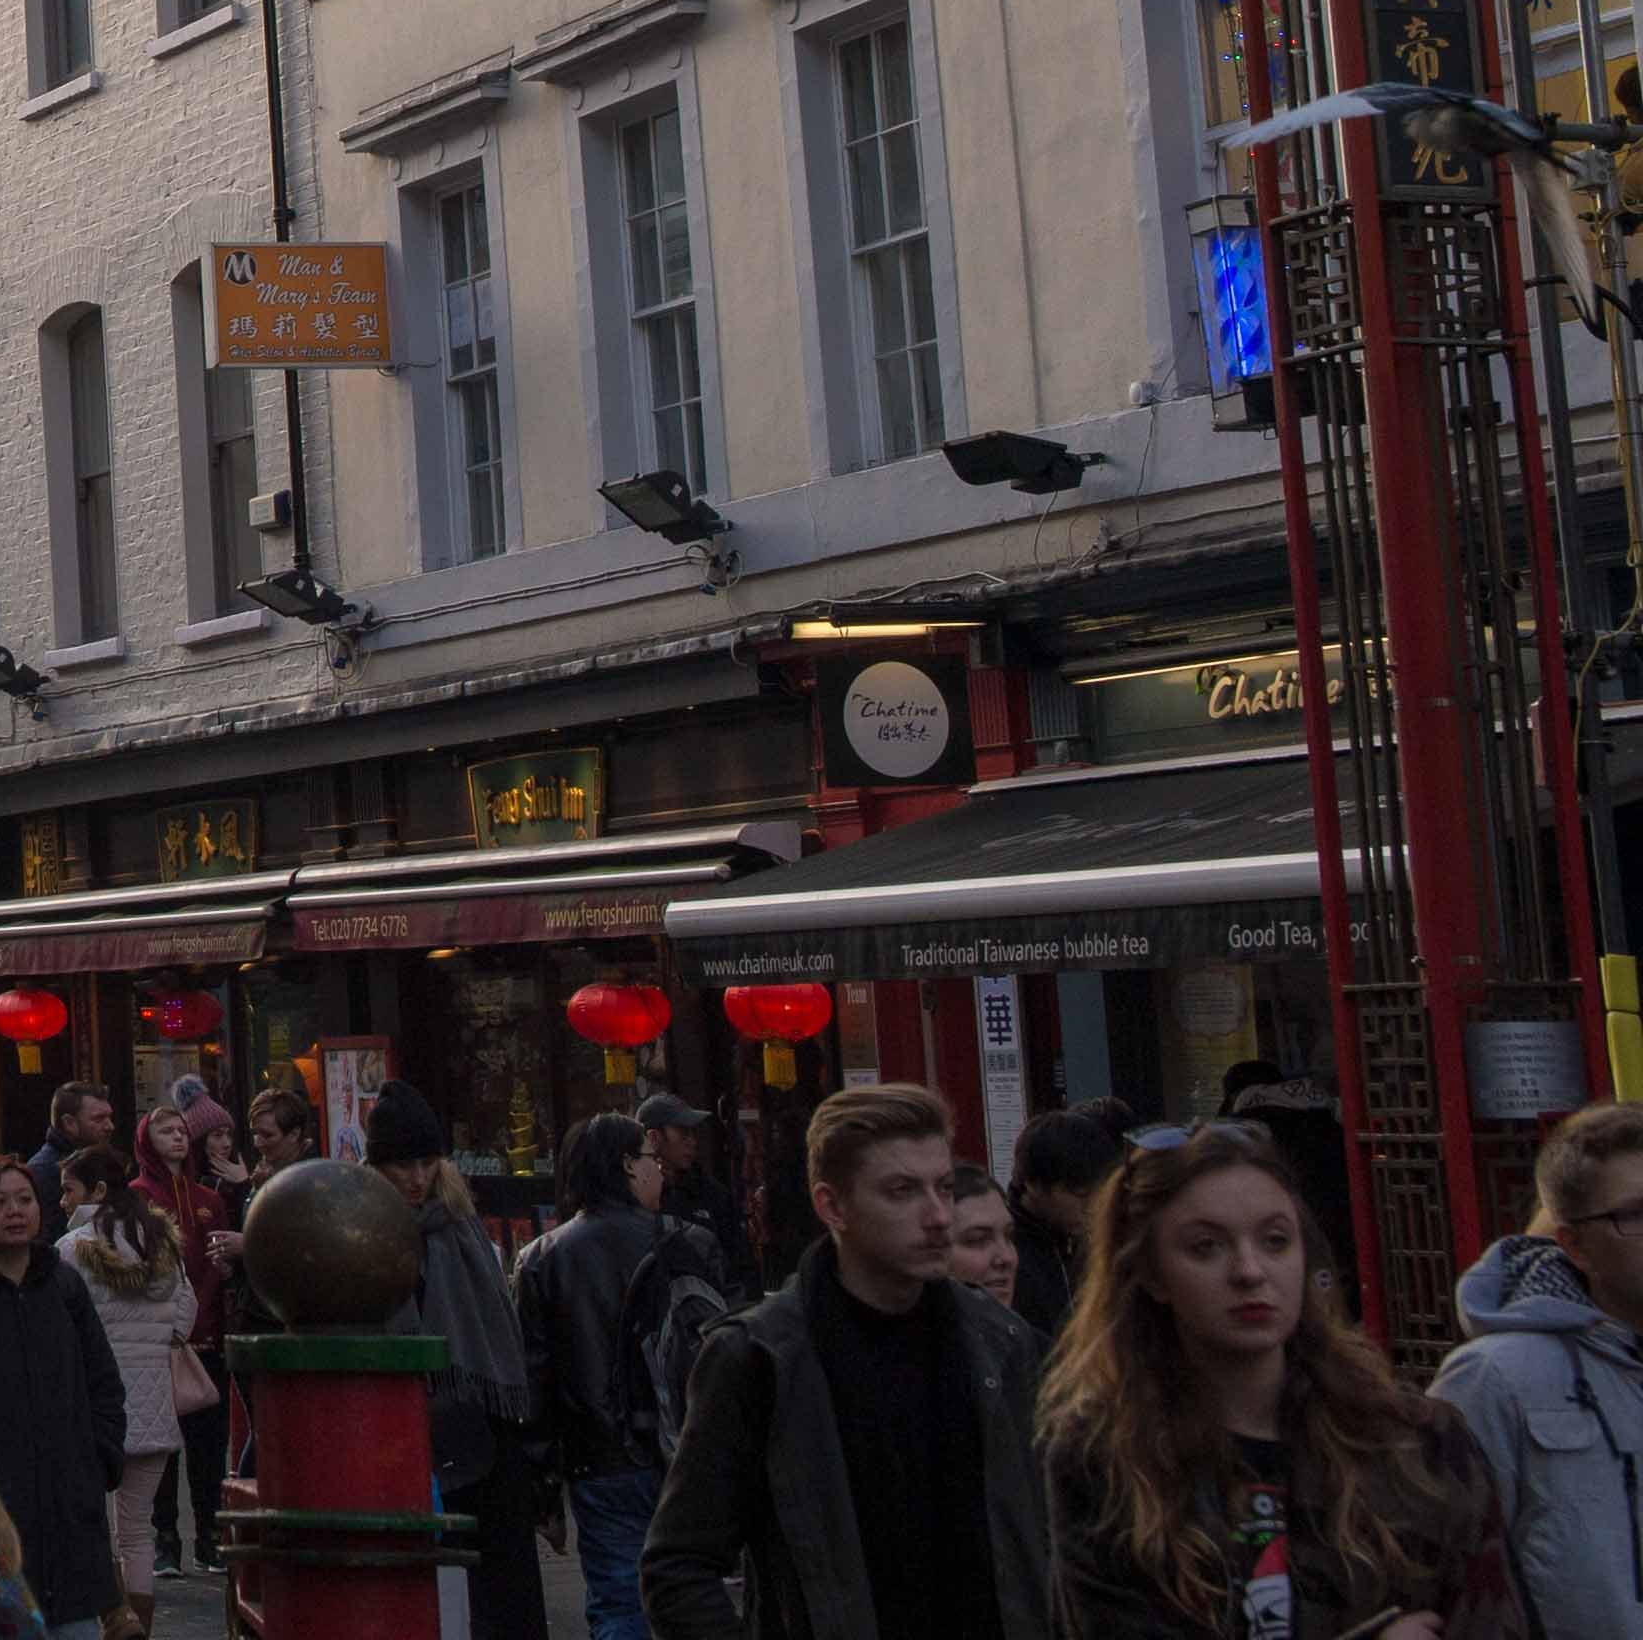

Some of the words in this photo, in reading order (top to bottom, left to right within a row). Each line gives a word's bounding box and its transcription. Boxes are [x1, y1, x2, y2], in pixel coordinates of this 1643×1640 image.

[278, 254, 322, 277] Man
[329, 255, 344, 277] &
[256, 282, 321, 311] Mary's
[327, 282, 379, 306] Team
[860, 701, 939, 718] Chatime
[1208, 670, 1346, 720] Chatie
[523, 775, 559, 821] Shui
[351, 916, 379, 938] 7734
[380, 914, 408, 936] 6778
[1227, 919, 1275, 947] Good
[1280, 920, 1317, 950] Tea,
[702, 950, 834, 976] www.chatimeuk.com
[901, 941, 979, 967] Traditional
[980, 939, 1059, 965] Taiwanese
[1064, 933, 1117, 959] bubble
[1121, 934, 1149, 956] tea
